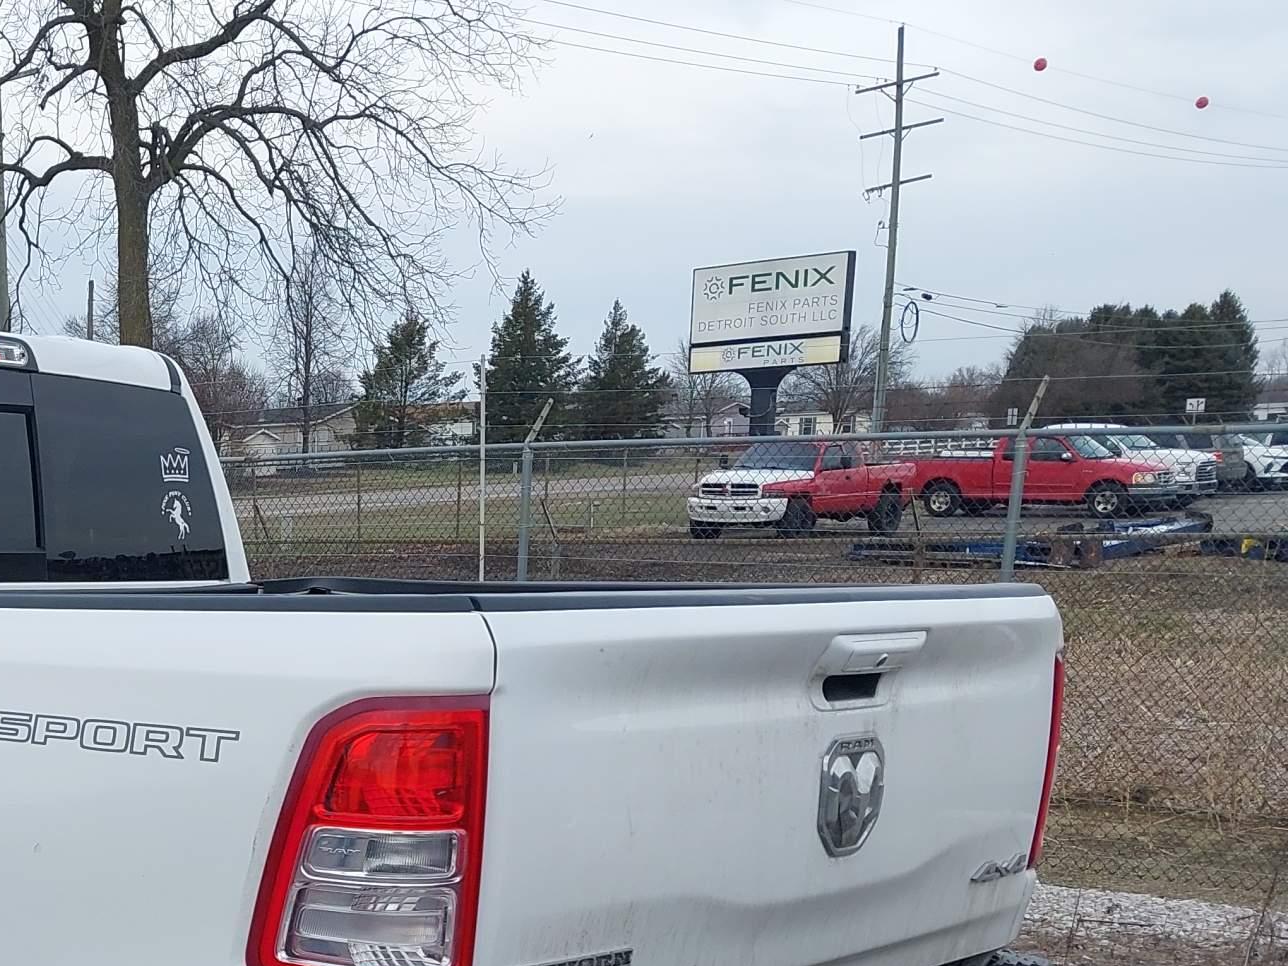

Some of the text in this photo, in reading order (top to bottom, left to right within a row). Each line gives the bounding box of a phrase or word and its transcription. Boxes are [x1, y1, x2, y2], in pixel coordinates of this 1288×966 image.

[728, 265, 836, 296] FENIX
[748, 294, 838, 314] FENIX PARTS
[698, 309, 838, 333] DETROIT SOUTH LLC
[737, 341, 805, 360] FENIX
[763, 356, 805, 366] PARTS
